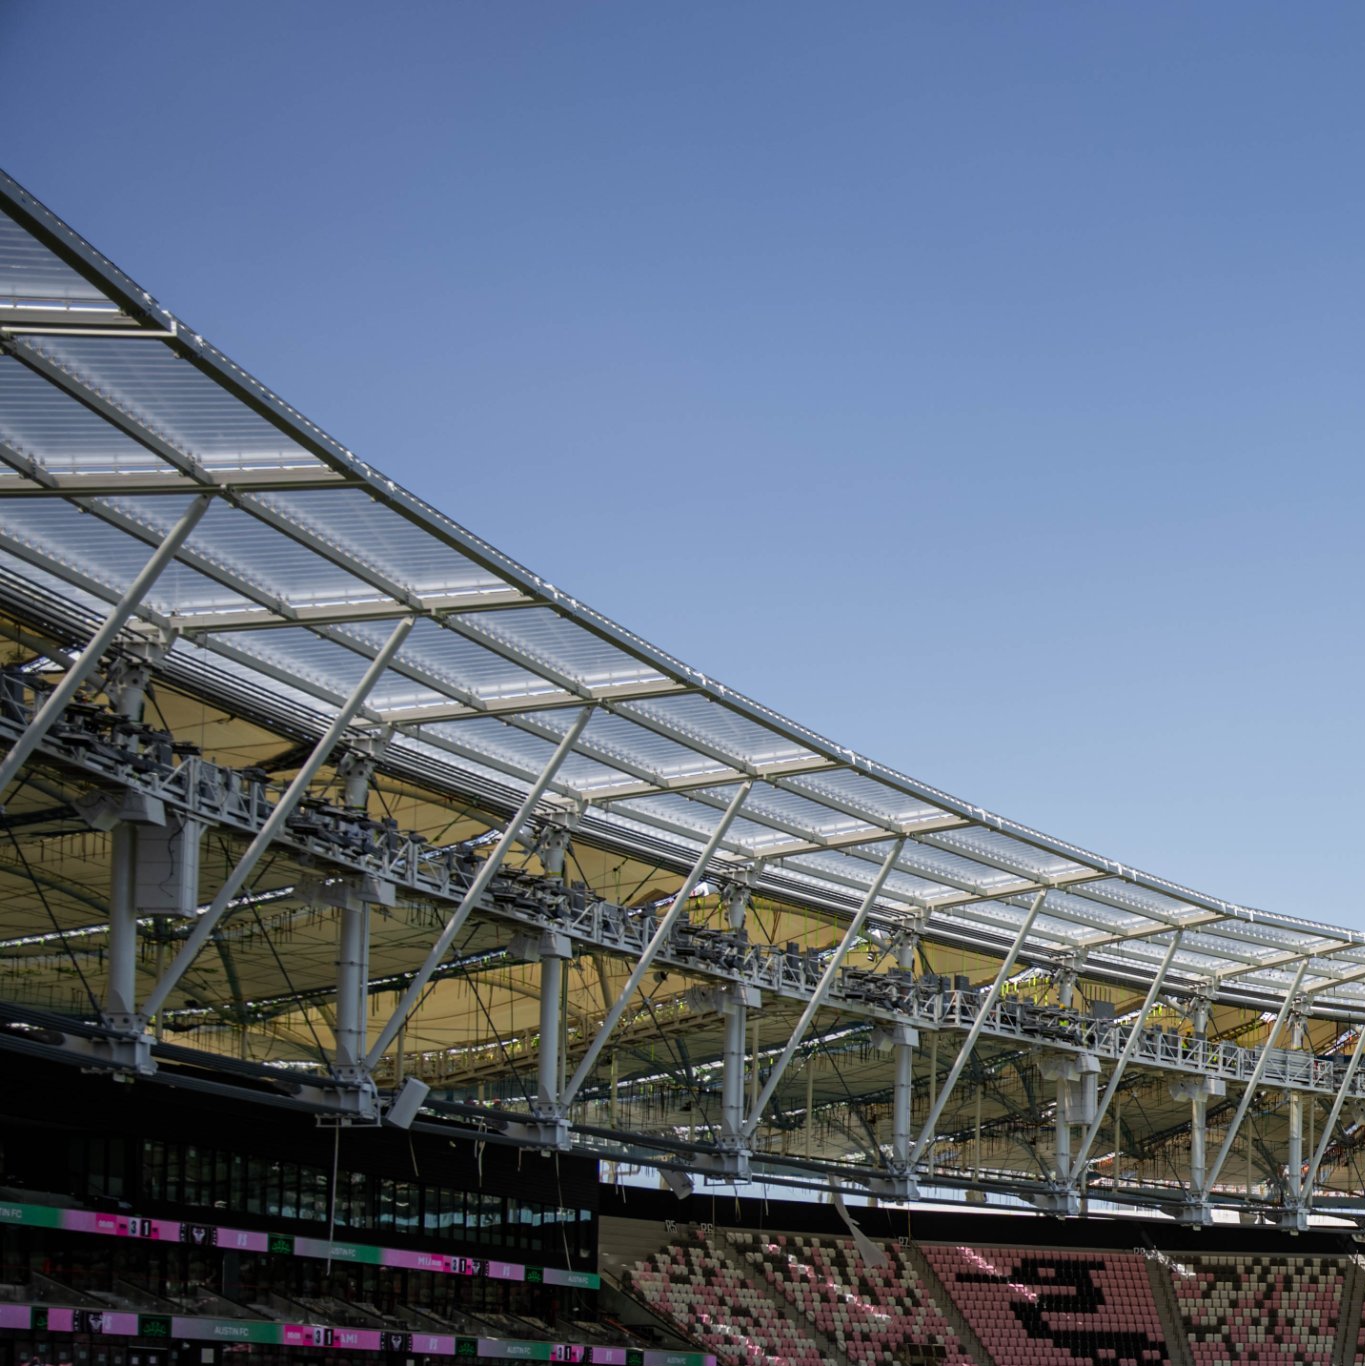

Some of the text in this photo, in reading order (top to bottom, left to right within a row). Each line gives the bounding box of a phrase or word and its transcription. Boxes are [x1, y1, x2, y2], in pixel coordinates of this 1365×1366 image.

[130, 1220, 137, 1235] 3
[143, 1221, 149, 1236] 1
[666, 1219, 678, 1233] R5
[214, 1325, 249, 1337] AUSTIN FC
[315, 1331, 321, 1344] 3
[326, 1332, 331, 1345] 1
